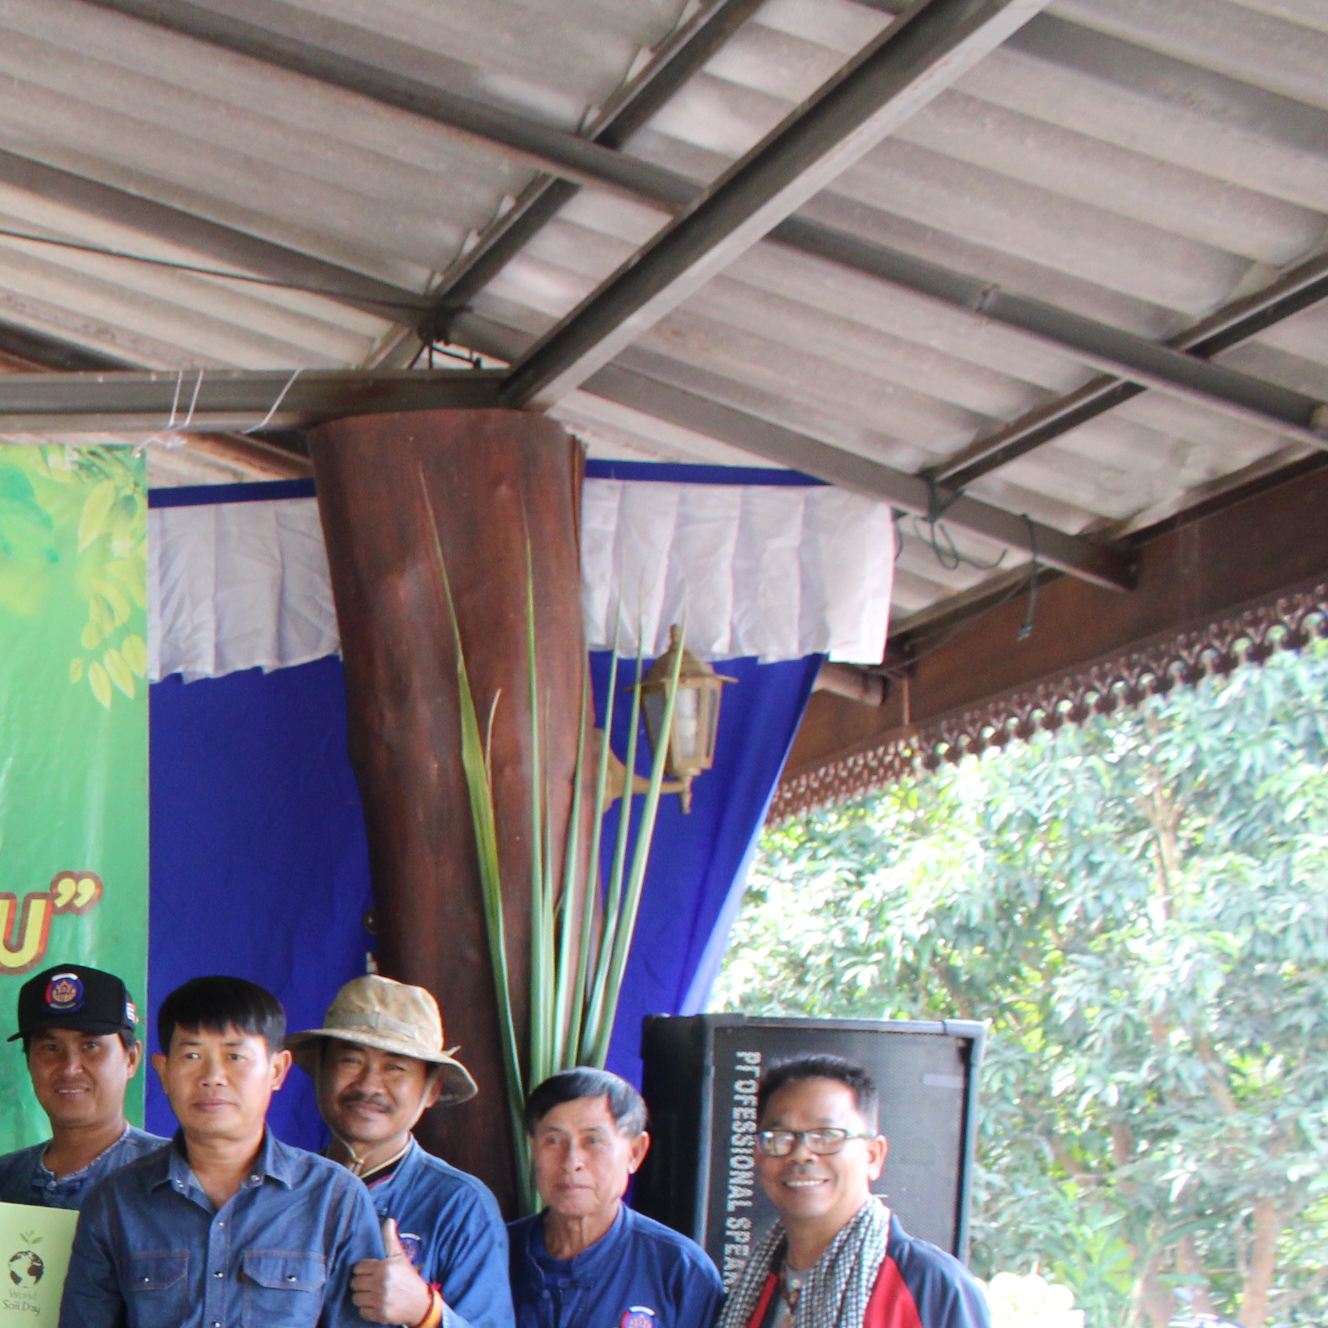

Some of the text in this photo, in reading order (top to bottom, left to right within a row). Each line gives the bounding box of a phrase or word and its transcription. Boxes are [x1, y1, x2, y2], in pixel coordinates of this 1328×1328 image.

[8, 1288, 38, 1300] World
[2, 1300, 41, 1317] Soil Day
